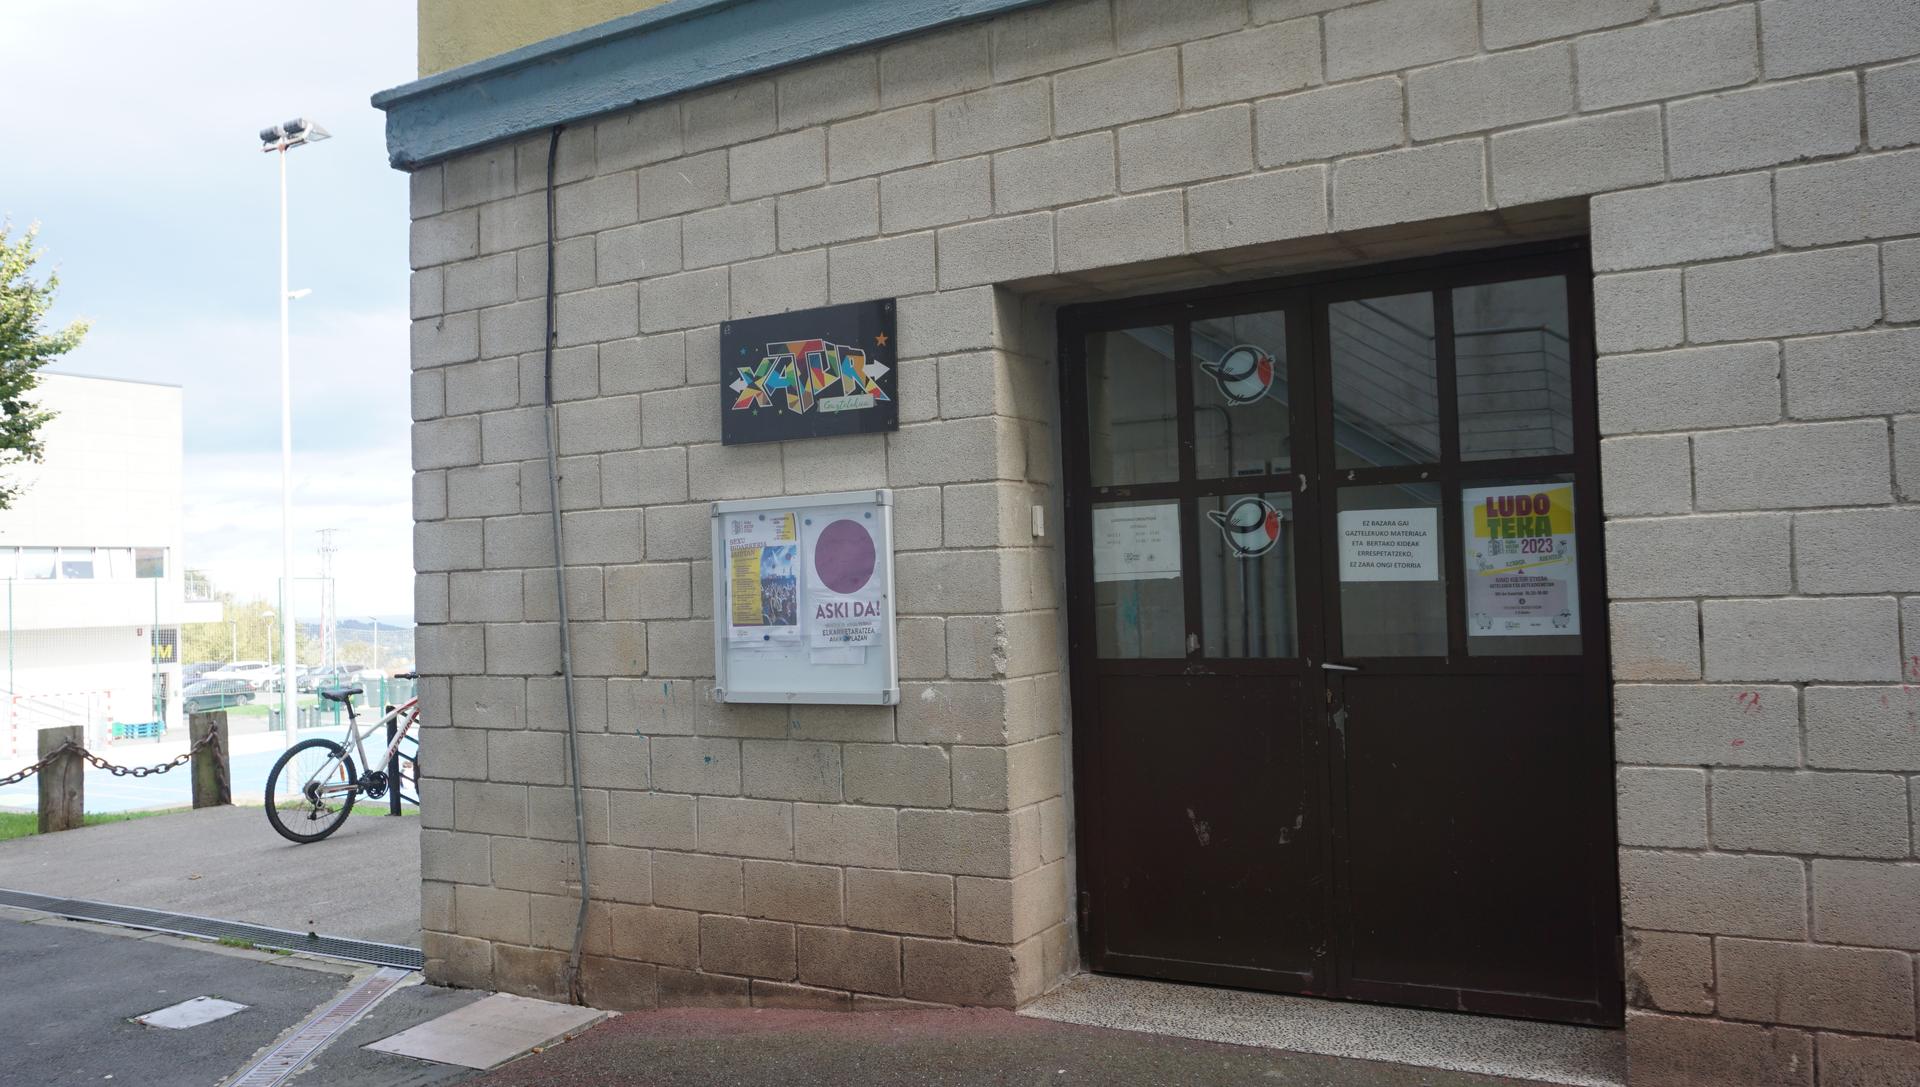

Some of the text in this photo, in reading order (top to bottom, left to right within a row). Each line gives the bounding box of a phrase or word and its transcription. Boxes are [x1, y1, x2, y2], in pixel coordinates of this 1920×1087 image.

[1486, 493, 1551, 517] LUDO
[1487, 516, 1553, 539] TEKA
[1521, 538, 1553, 554] 2023
[815, 600, 881, 620] ASKI DA!
